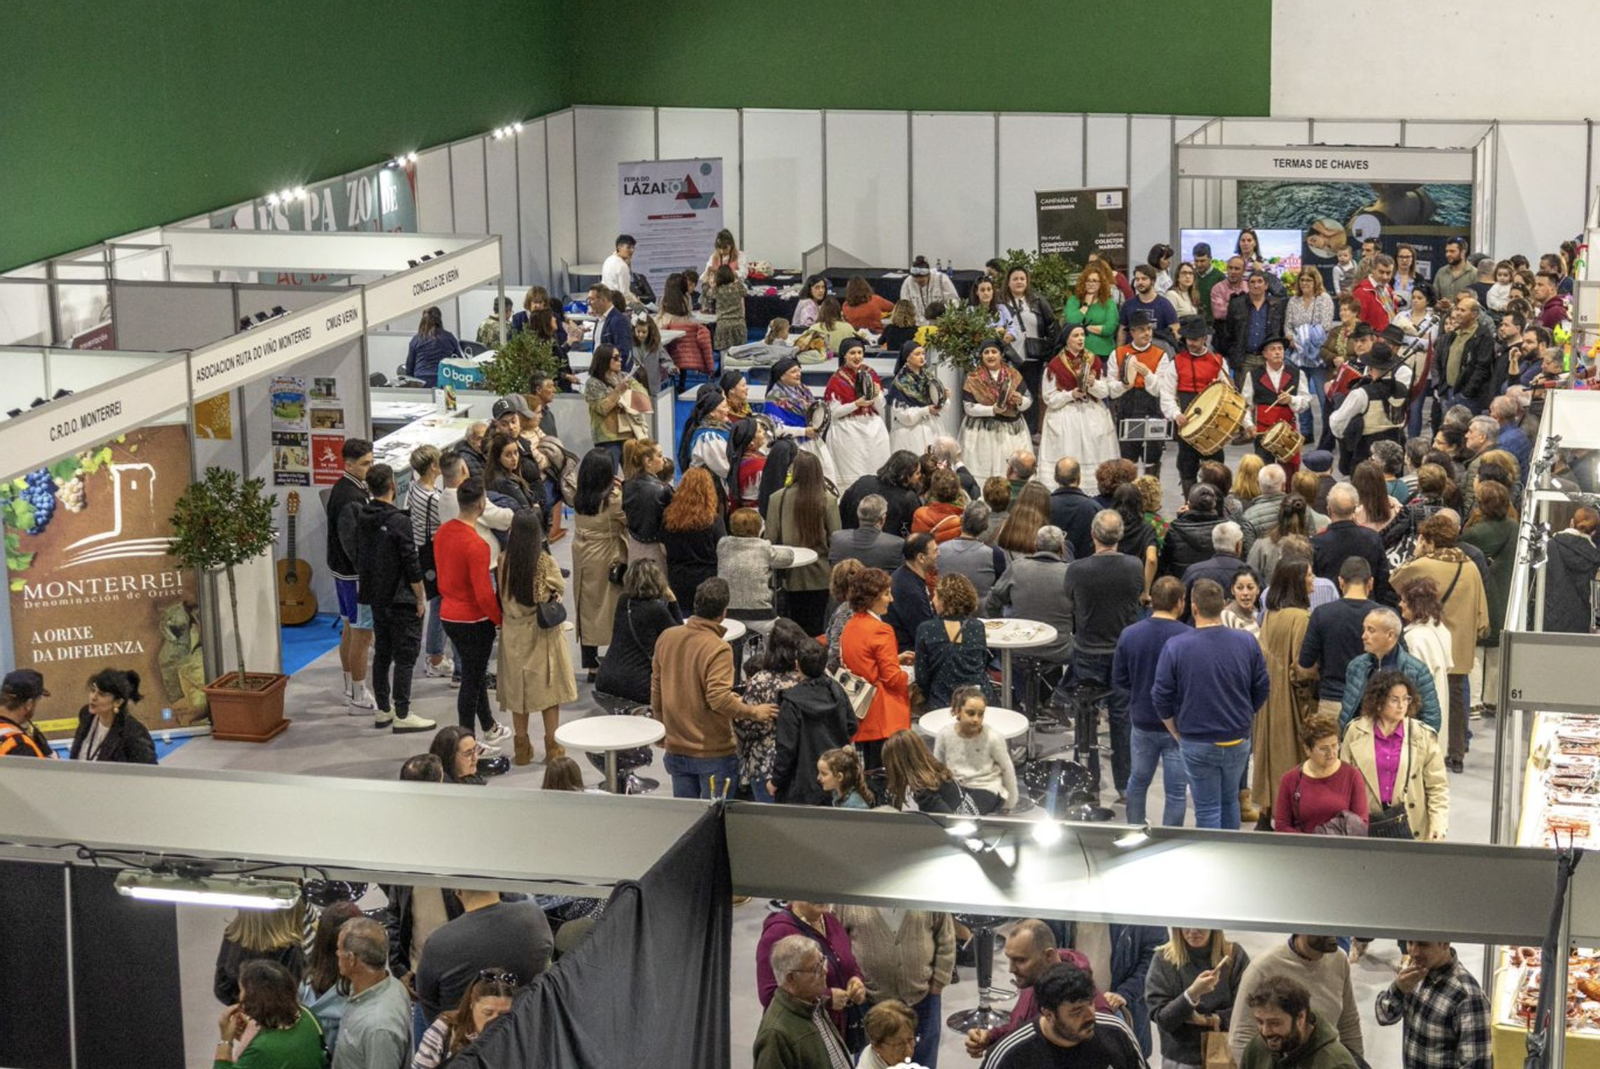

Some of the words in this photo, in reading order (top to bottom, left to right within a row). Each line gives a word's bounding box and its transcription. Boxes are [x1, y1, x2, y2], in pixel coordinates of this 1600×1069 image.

[1273, 158, 1312, 169] TERMAS
[1315, 159, 1328, 169] DE
[1330, 160, 1369, 170] CHAVES
[1040, 197, 1070, 205] CAMPAÑA
[412, 276, 440, 296] CONCELLO
[438, 273, 446, 286] DE
[445, 265, 460, 283] VERÍN
[326, 313, 342, 331] CMUS
[341, 304, 358, 324] VERÍN
[196, 357, 235, 382] ASOCIACION
[235, 350, 252, 368] RUTA
[252, 345, 262, 360] DO
[262, 337, 278, 355] VIÑO
[278, 326, 312, 351] MONTERREI
[442, 367, 451, 378] O
[452, 369, 473, 388] bag
[49, 418, 80, 441] C.R.D.O.
[80, 400, 123, 430] MONTERREI
[23, 571, 183, 600] MONTERREI
[23, 592, 120, 609] Denominación
[126, 591, 141, 599] de
[148, 587, 184, 599] Orixe
[31, 631, 42, 645] A
[44, 625, 94, 642] ORIXE
[33, 650, 54, 663] DA
[57, 639, 145, 661] DIFERENZA
[1511, 688, 1523, 700] 61
